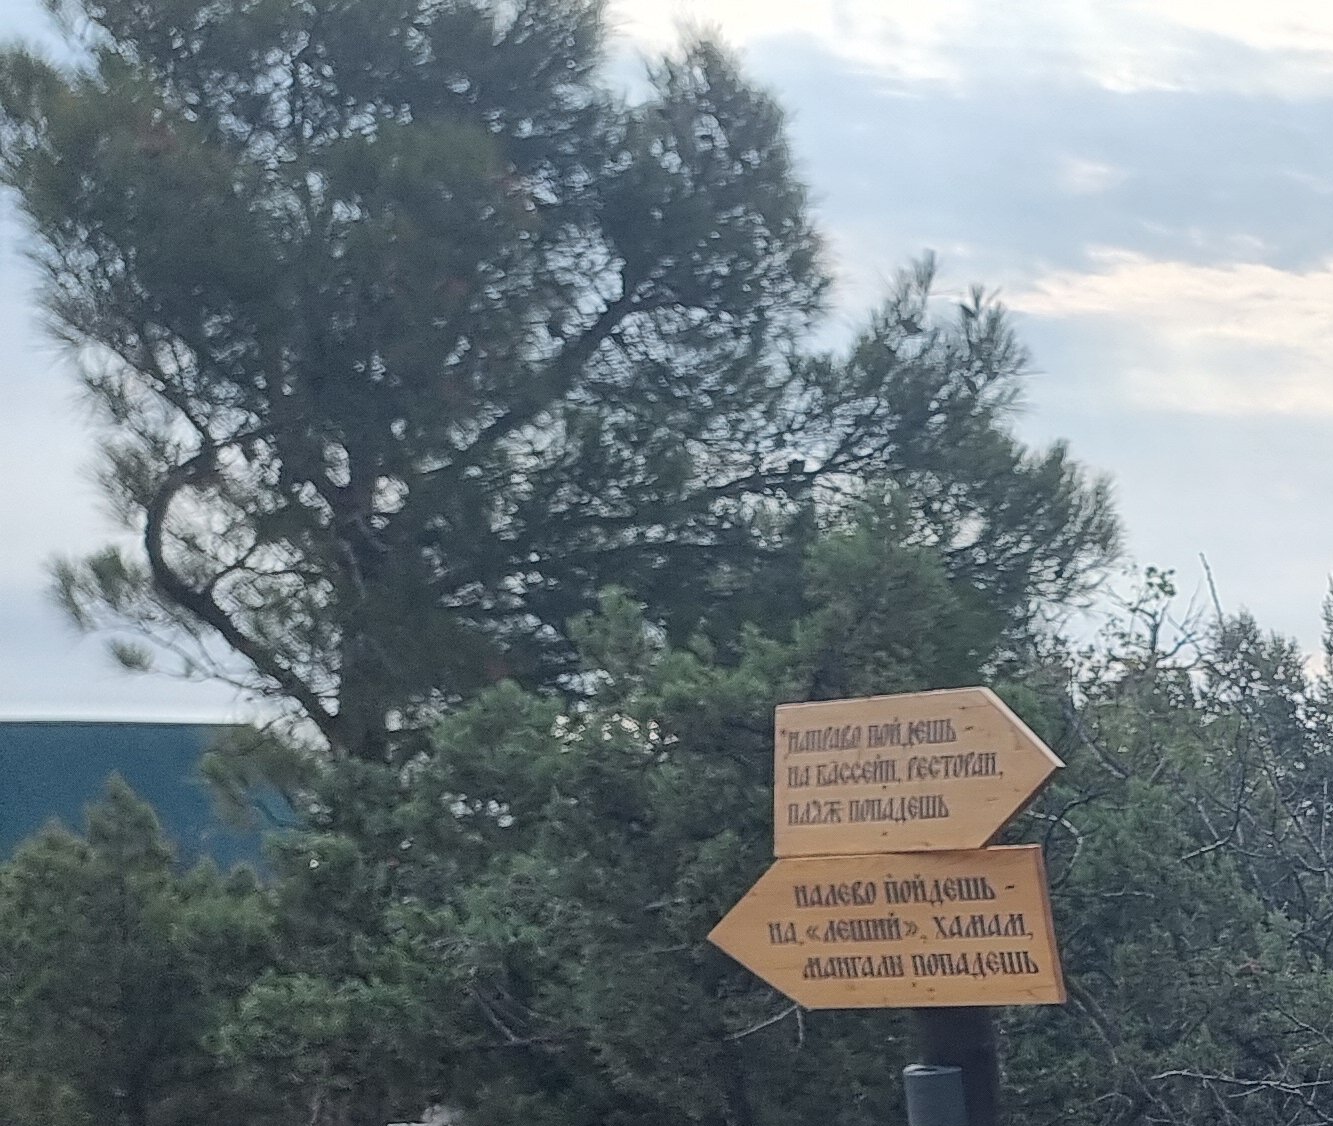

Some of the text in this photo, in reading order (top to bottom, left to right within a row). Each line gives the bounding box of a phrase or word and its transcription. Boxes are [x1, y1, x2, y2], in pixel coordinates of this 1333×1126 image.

[787, 725, 862, 755] НАПРАВО
[866, 717, 957, 749] ПОЙДЕШЬ
[787, 765, 810, 788] НА
[907, 751, 1003, 782] РЕСТОРАН,
[848, 794, 950, 824] ПОПАДЕШЬ
[793, 880, 877, 909] НАЛЕВО
[883, 873, 996, 907] ПОЙДЕШЬ
[768, 920, 798, 946] НА
[932, 912, 1034, 941] ХАМАМ,
[911, 950, 1040, 979] ПОПАДЕШЬ
